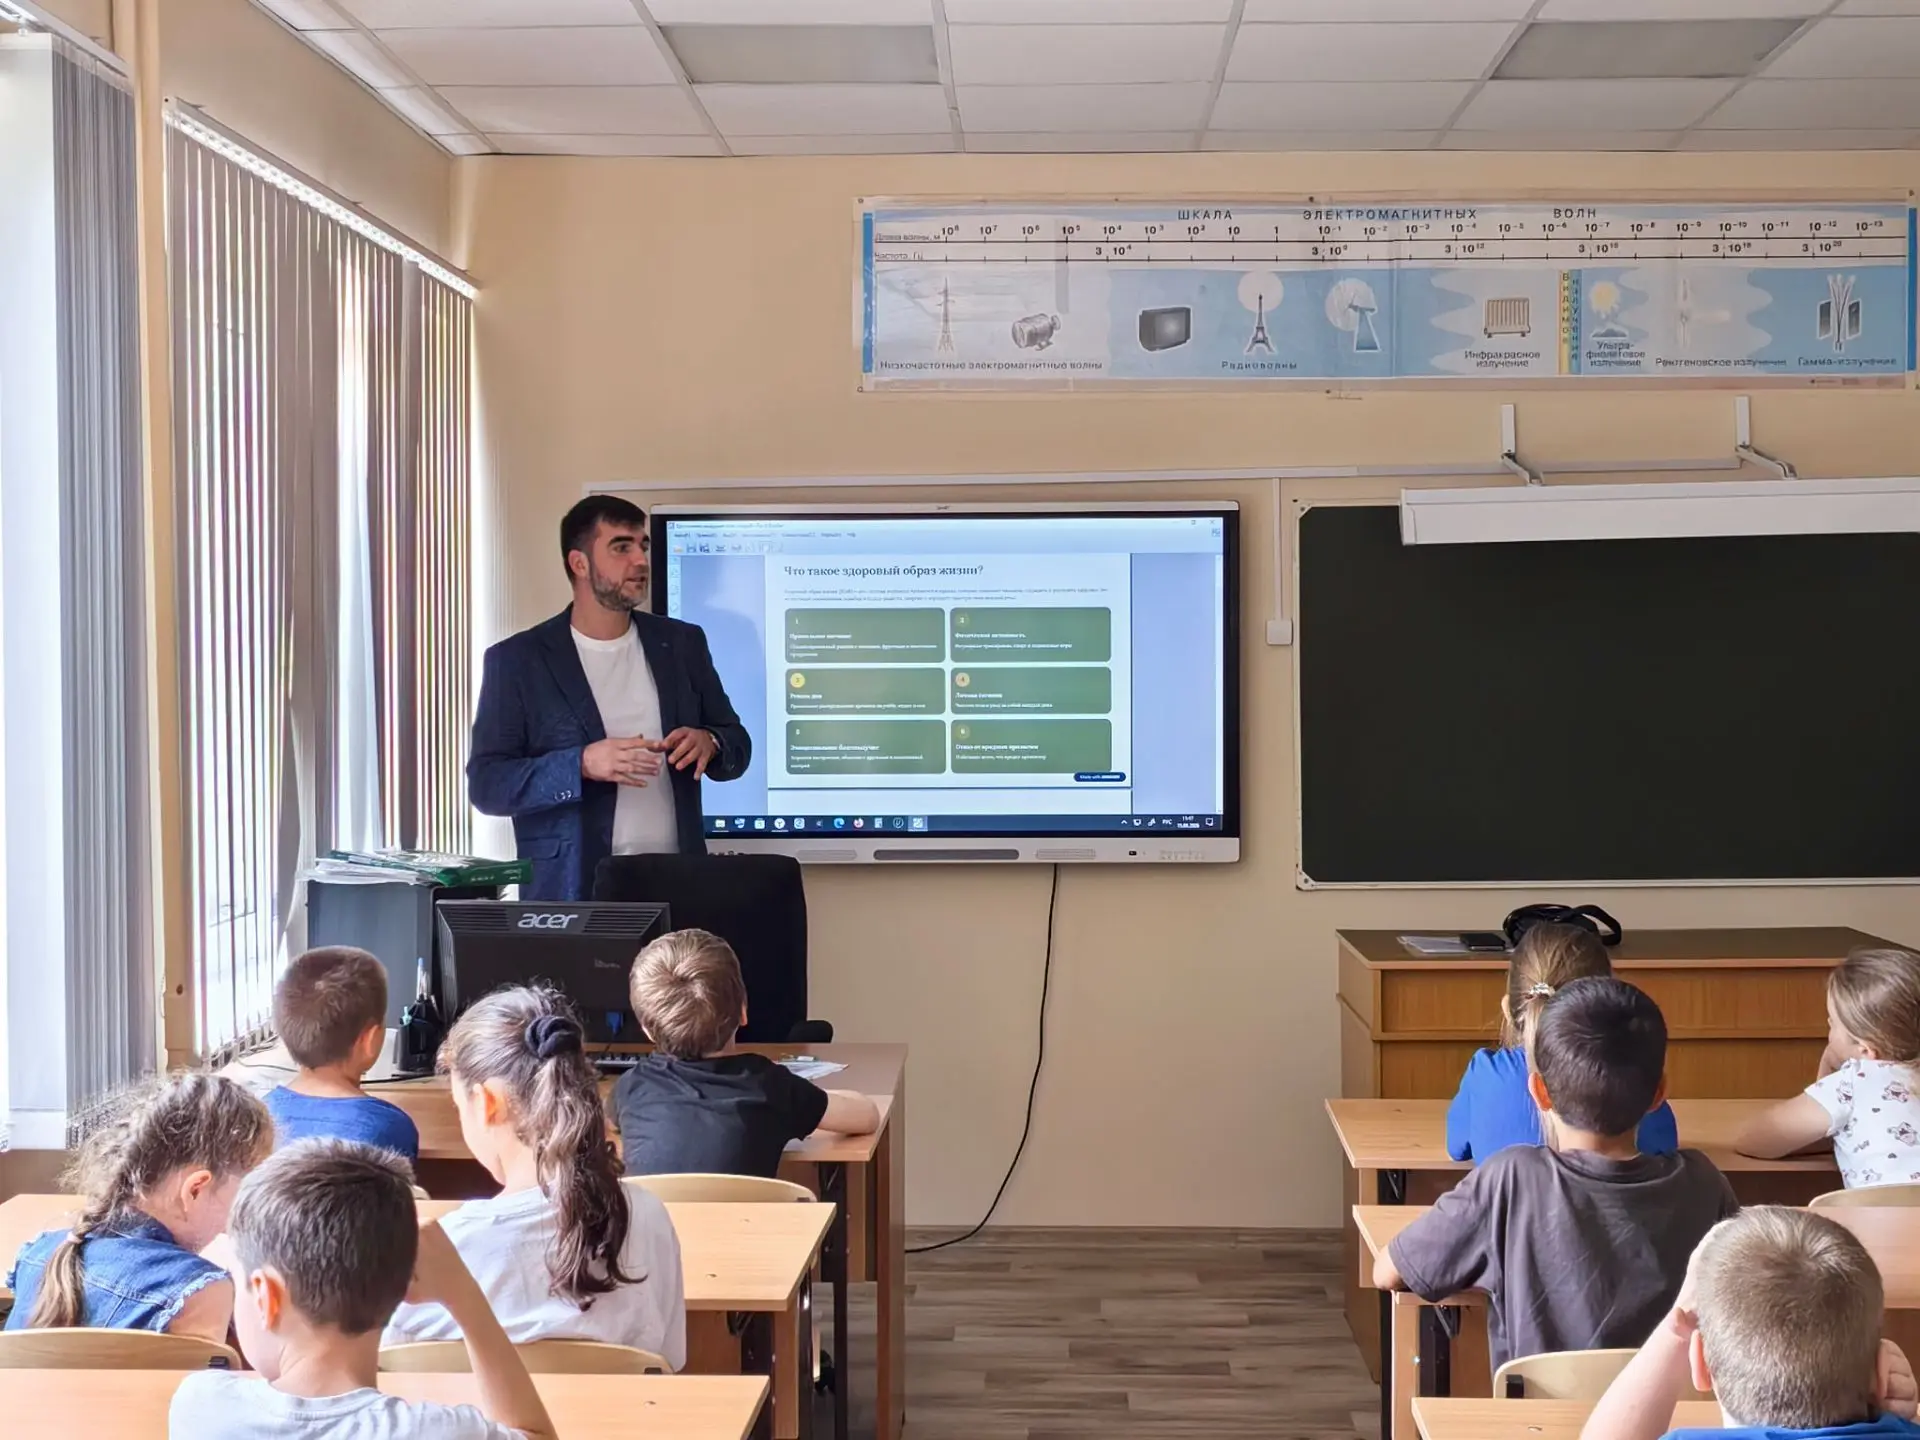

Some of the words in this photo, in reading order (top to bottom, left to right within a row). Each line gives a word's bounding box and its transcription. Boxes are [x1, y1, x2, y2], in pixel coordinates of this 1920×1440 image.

[1177, 209, 1233, 220] ШКАЛА
[1303, 208, 1477, 221] ЭЛЕКТРОМАГНИТНЫХ
[1553, 208, 1597, 219] ВОЛН
[1228, 226, 1240, 235] 10
[1274, 226, 1279, 234] 1
[1596, 341, 1634, 351] Ультра-
[1464, 351, 1541, 361] Инфракрасное
[880, 360, 966, 370] Низкочастотные
[969, 361, 1067, 371] электромагнитные
[1221, 360, 1297, 370] Радиоволны
[1476, 360, 1529, 368] излучение
[784, 566, 805, 576] Что
[807, 567, 840, 576] такое
[843, 565, 900, 578] здоровый
[903, 565, 936, 578] образ
[938, 565, 984, 576] жизни?
[517, 912, 579, 930] acer
